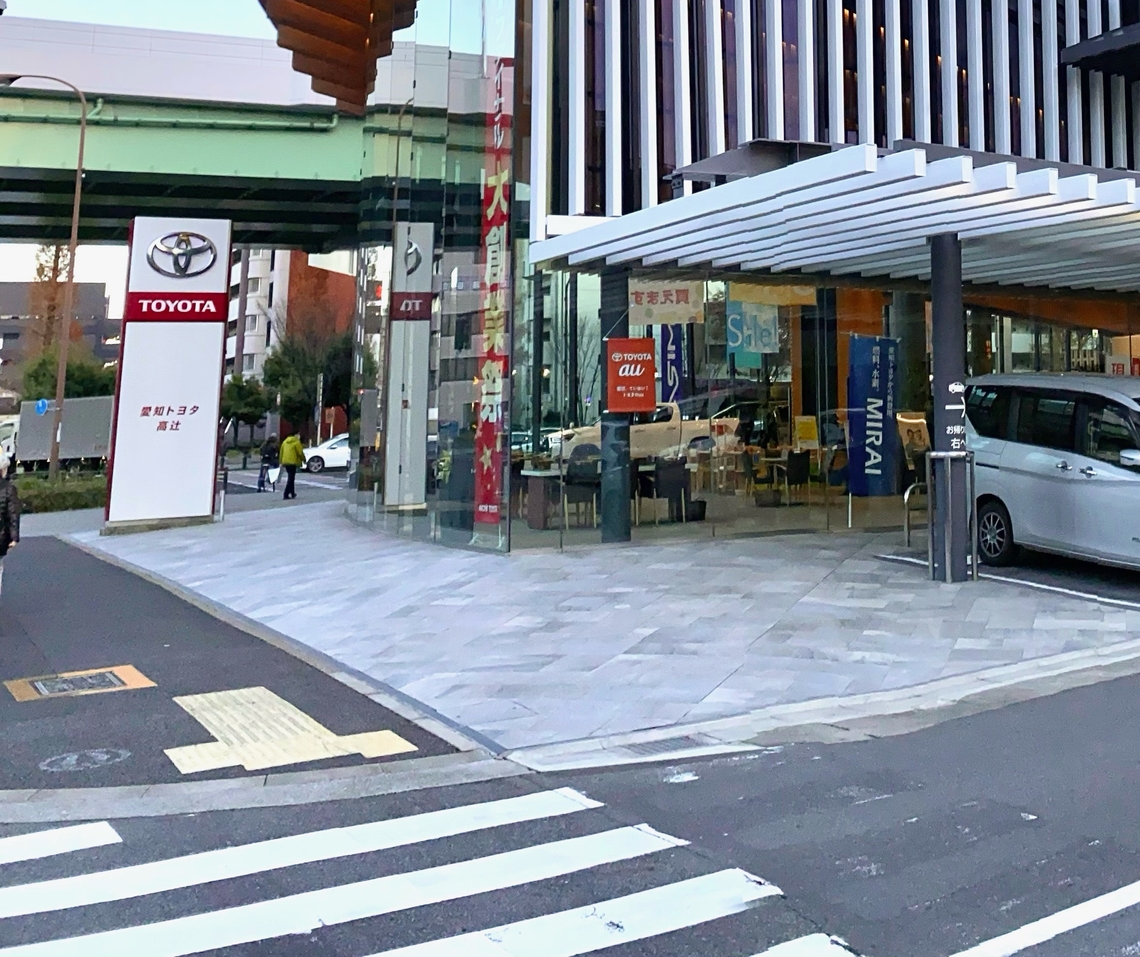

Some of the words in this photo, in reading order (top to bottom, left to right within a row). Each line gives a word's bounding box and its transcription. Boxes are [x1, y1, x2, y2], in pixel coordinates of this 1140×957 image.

[138, 299, 217, 313] TOYOTA
[624, 353, 652, 361] TOYOTA
[618, 363, 645, 377] au
[140, 406, 199, 417] 愛知トヨタ
[865, 398, 883, 475] MIRAI
